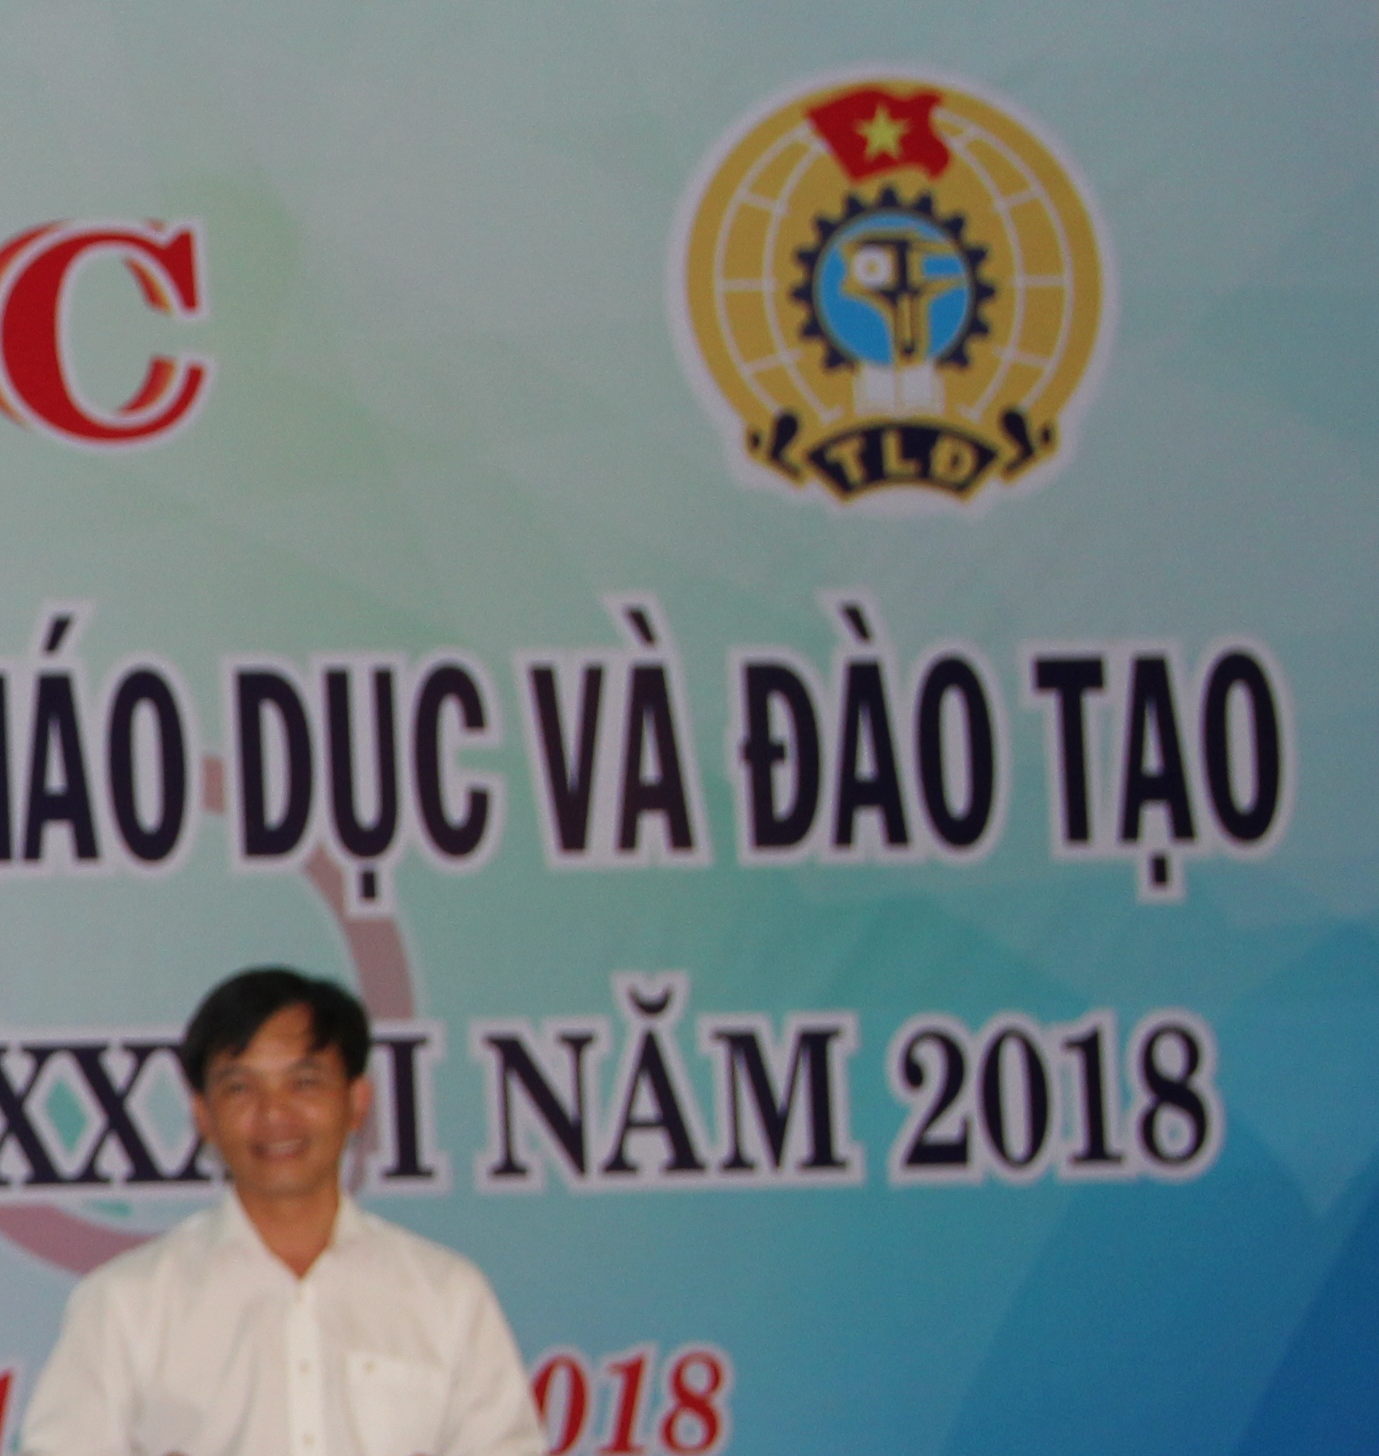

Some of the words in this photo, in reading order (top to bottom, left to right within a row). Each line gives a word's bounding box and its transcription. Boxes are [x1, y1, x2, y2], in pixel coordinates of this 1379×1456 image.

[235, 662, 492, 901] DỤC
[529, 607, 697, 855] VÀ
[742, 604, 995, 852] ĐÀO
[1033, 650, 1283, 889] TẠO
[484, 986, 852, 1179] NĂM
[899, 1020, 1212, 1172] 2018
